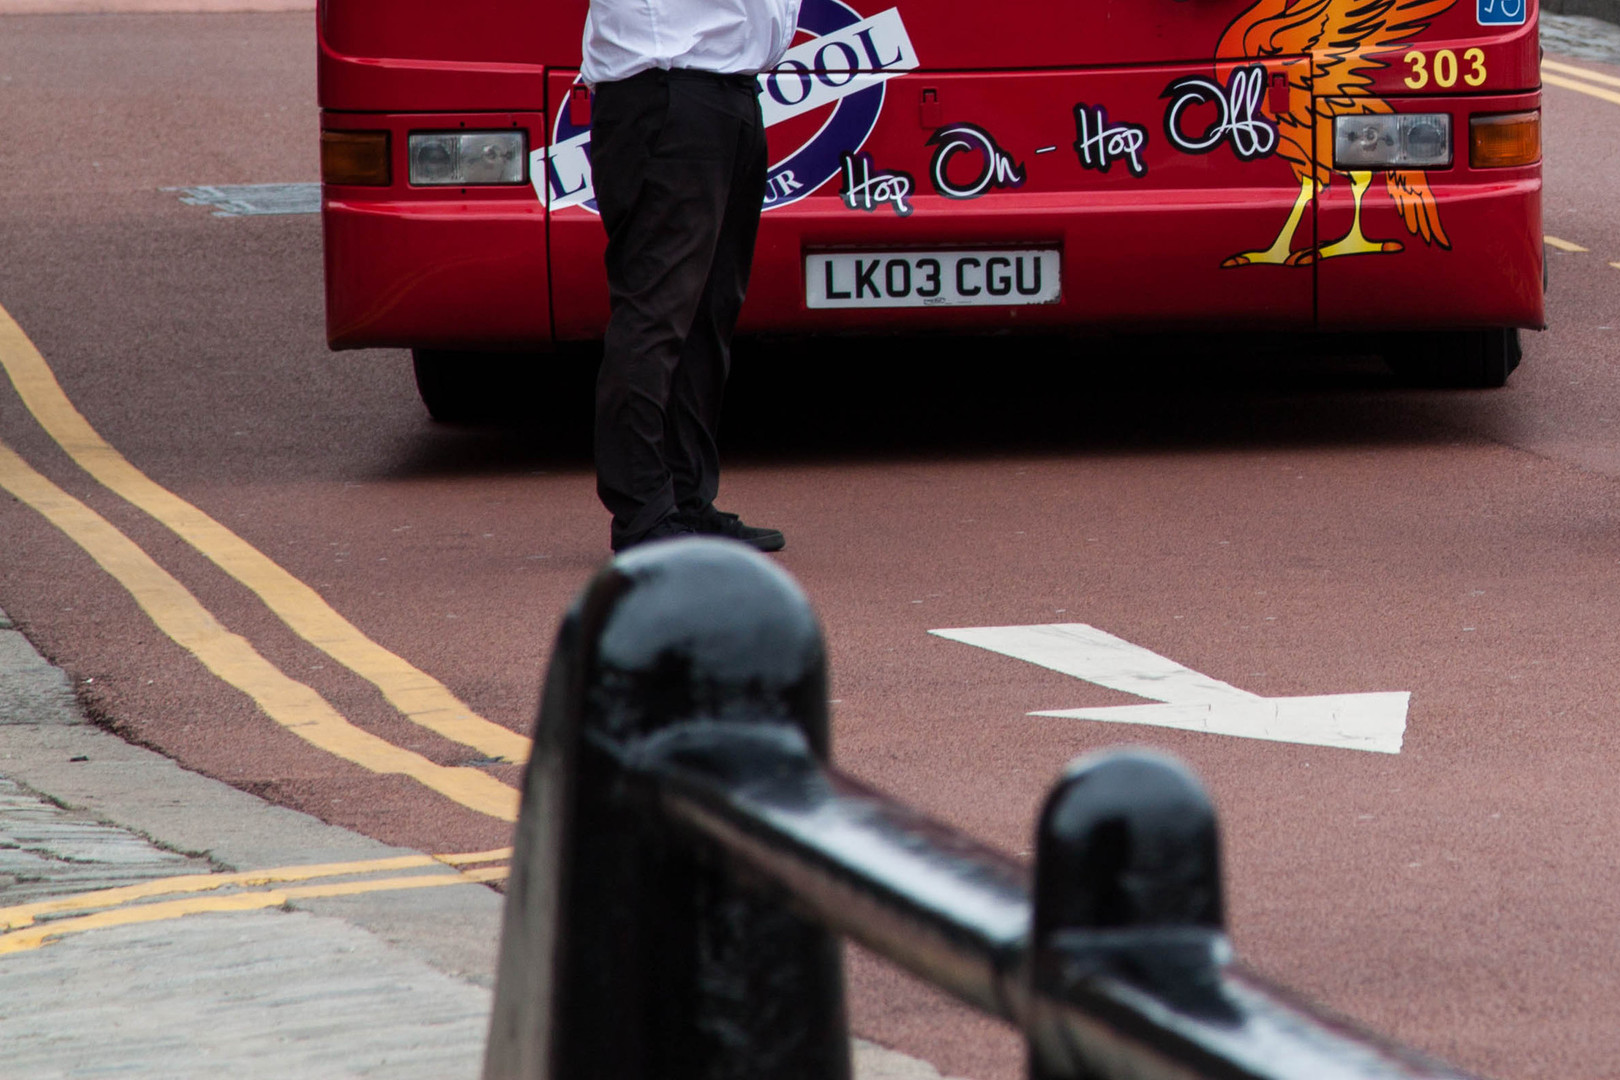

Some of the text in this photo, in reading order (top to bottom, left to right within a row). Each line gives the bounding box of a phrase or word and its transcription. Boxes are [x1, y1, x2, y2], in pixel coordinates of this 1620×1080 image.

[1403, 47, 1488, 90] 303
[846, 155, 910, 213] Hop
[935, 126, 1021, 198] On
[1079, 107, 1145, 173] Hop
[1168, 67, 1276, 157] Off
[763, 170, 804, 204] UR
[825, 255, 1042, 300] LK03 CGU
